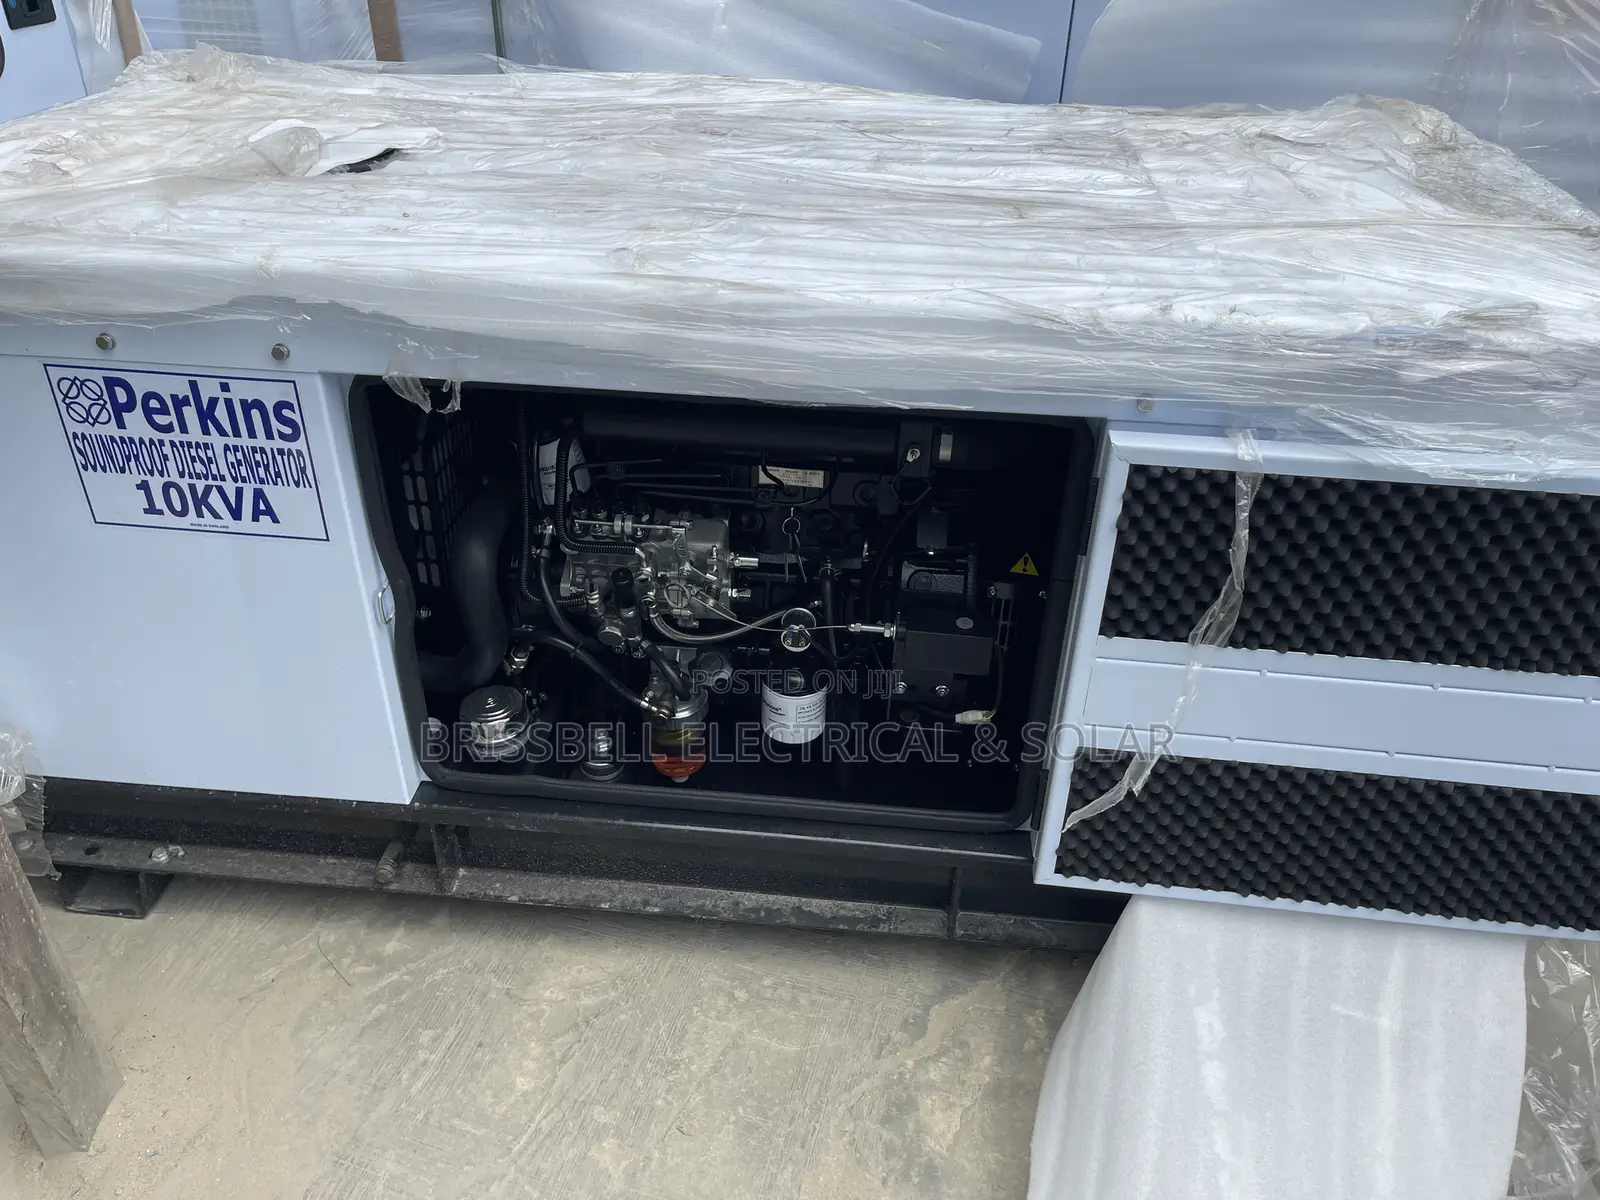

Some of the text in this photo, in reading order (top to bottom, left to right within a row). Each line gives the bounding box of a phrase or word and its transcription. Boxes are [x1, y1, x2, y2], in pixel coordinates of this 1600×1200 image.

[102, 376, 301, 443] Perkins
[72, 431, 313, 489] SOUNDPROOF DIESEL GENERATOR
[135, 479, 281, 524] 10KVA
